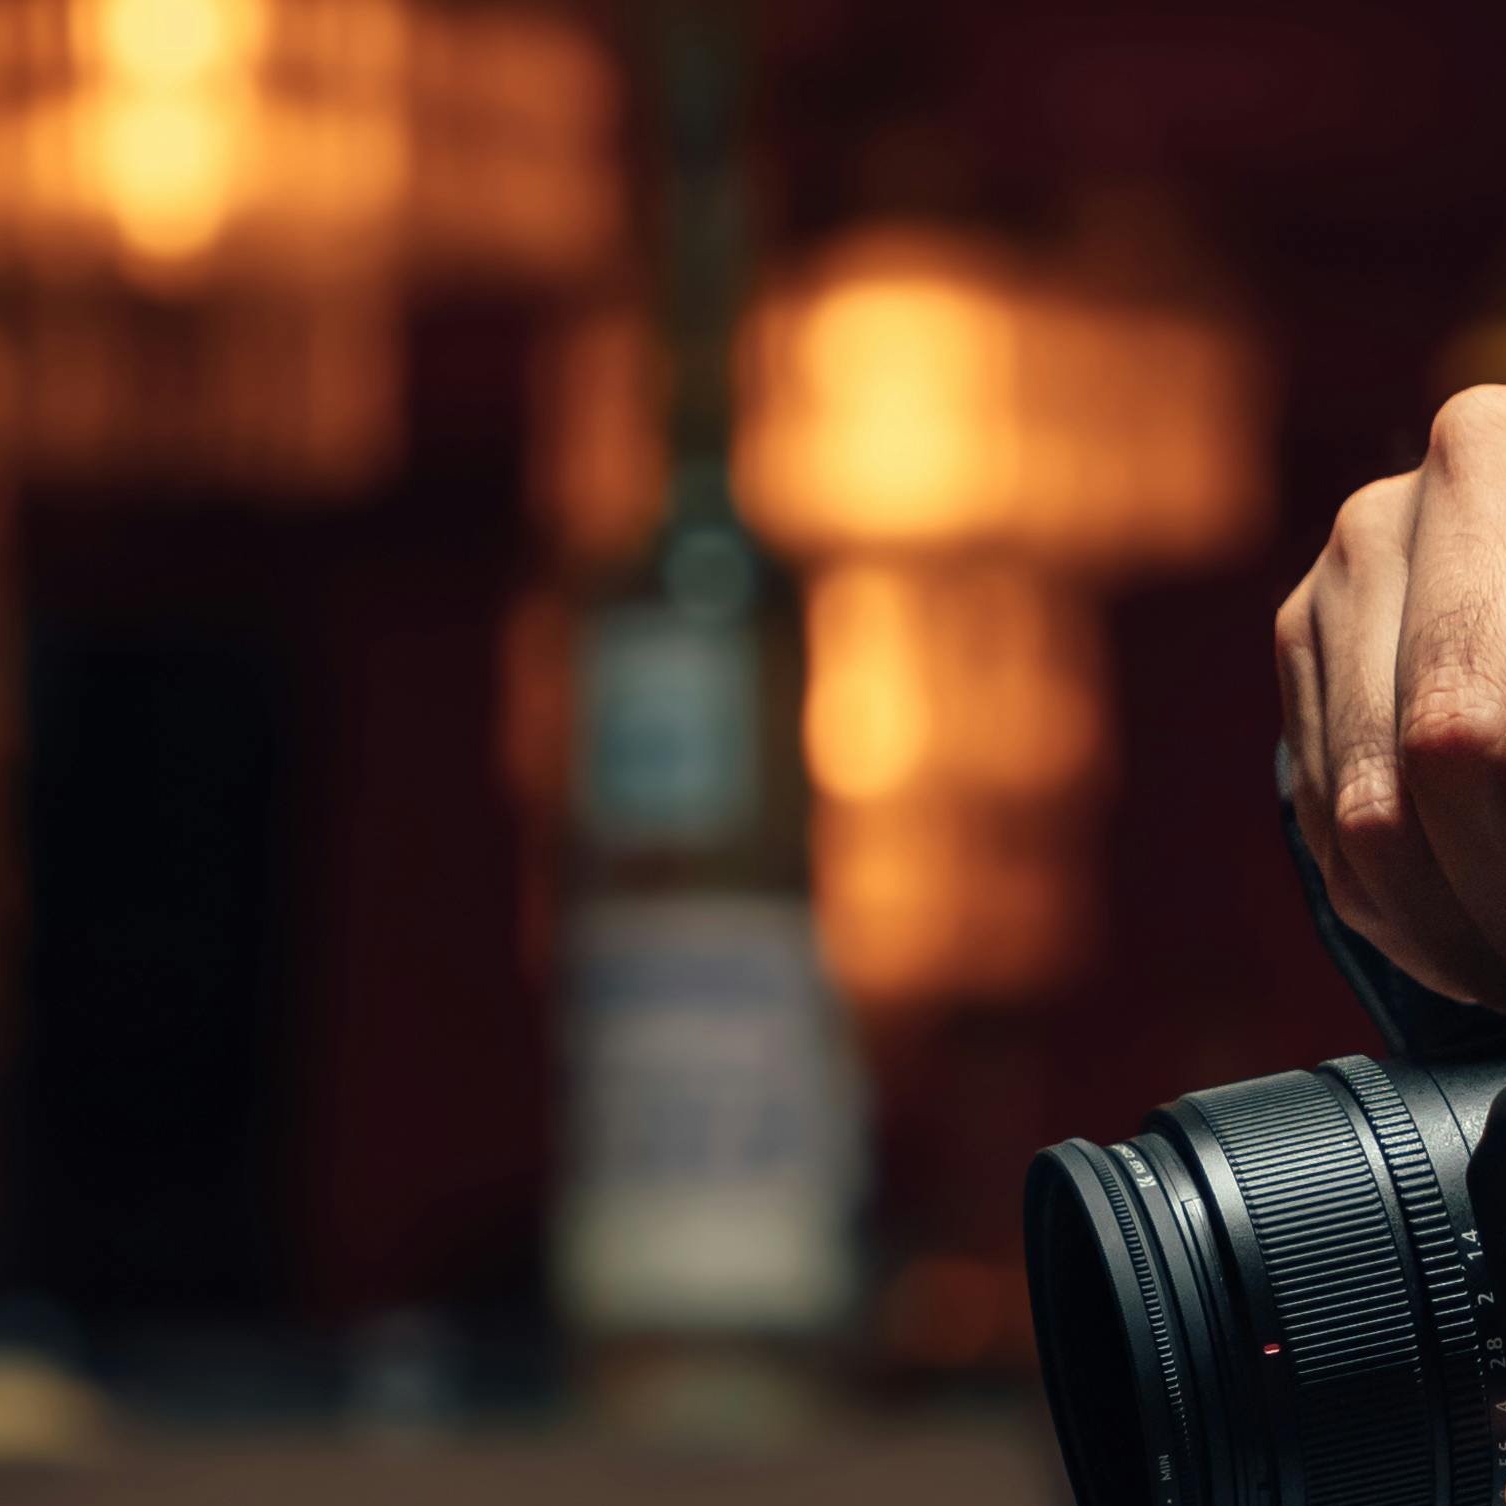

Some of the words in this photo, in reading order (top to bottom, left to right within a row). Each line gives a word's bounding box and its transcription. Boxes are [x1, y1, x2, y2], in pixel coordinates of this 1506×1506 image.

[1461, 1227, 1484, 1261] 1.4
[1477, 1290, 1495, 1306] 2
[1158, 1453, 1172, 1482] MIN
